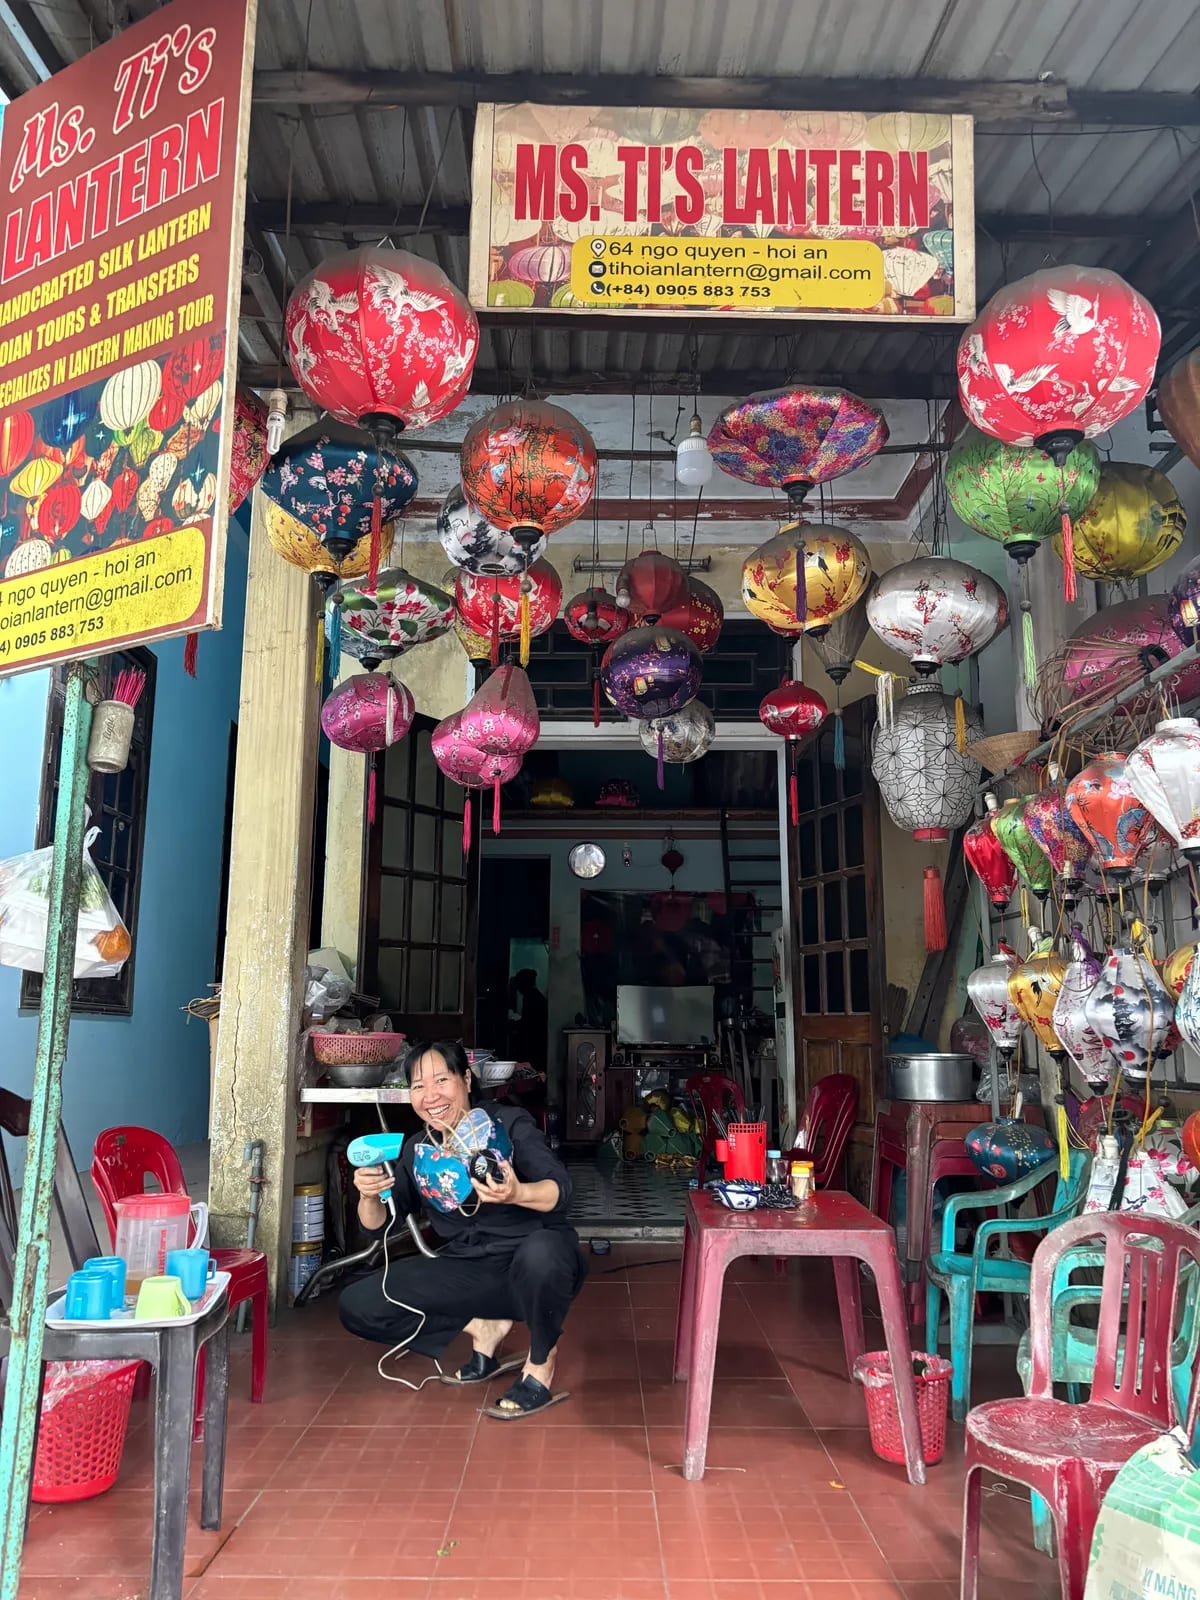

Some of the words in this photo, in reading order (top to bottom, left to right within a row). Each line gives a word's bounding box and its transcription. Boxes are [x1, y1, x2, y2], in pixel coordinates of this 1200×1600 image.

[9, 102, 96, 193] Ms.
[113, 24, 217, 135] Ti's
[1, 97, 225, 285] LANTERN
[514, 143, 600, 223] MS.
[617, 146, 705, 225] TI'S
[722, 147, 930, 228] LANTERN
[98, 239, 135, 280] SILK
[138, 201, 212, 262] LANTERN
[608, 261, 871, 282] tihoianlantern@gmail.com
[609, 241, 633, 256] 64
[641, 245, 678, 260] ngo
[685, 245, 746, 261] quyen
[767, 244, 796, 259] hoi
[803, 248, 828, 260] an
[36, 305, 86, 350] TOURS
[89, 303, 102, 327] &
[106, 253, 200, 320] TRANSFERS
[606, 283, 650, 298] (+84)
[656, 284, 697, 296] 0905
[703, 285, 734, 297] 883
[740, 286, 771, 297] 753
[53, 356, 67, 387] IN
[69, 333, 120, 380] LANTERN
[122, 310, 174, 358] MAKING
[178, 294, 214, 335] TOUR
[0, 566, 192, 631] oianlantern@gmail.com
[8, 586, 36, 606] ngo
[40, 570, 88, 597] quyen
[104, 555, 130, 577] hoi
[134, 551, 156, 569] an
[15, 630, 46, 650] 0905
[50, 624, 75, 641] 883
[79, 616, 104, 634] 753
